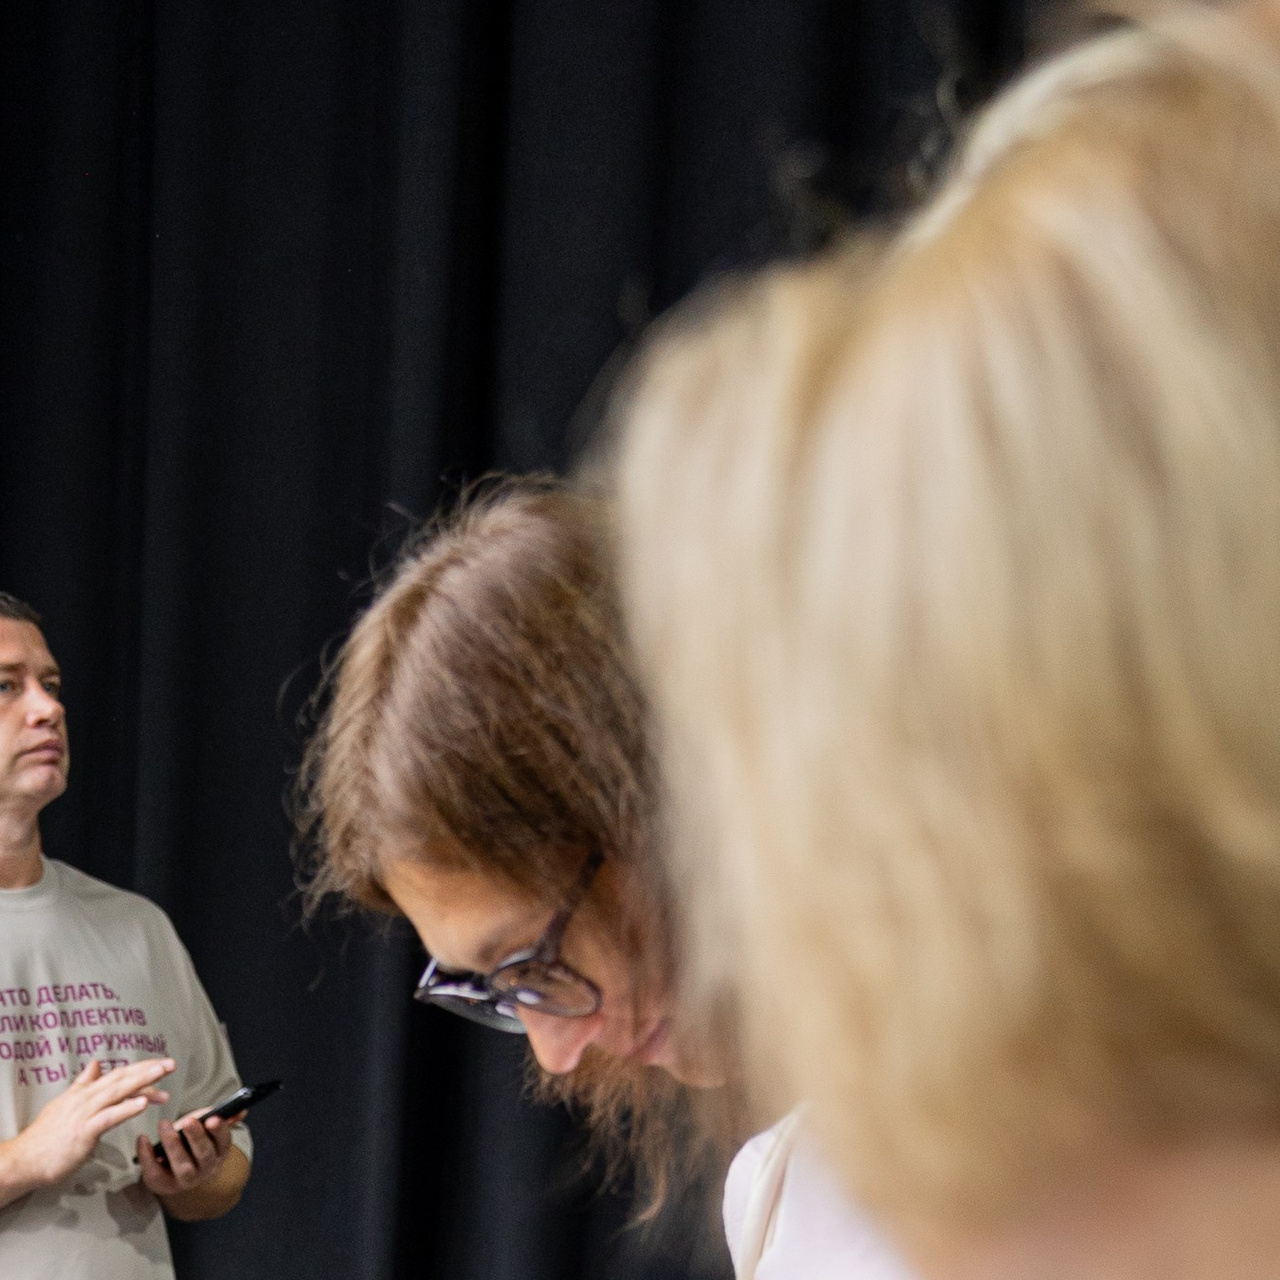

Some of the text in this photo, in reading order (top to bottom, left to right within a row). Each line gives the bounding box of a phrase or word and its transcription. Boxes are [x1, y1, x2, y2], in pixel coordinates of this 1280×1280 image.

[28, 1006, 148, 1033] КОЛЛЕКТИВ
[57, 1036, 72, 1054] И
[30, 1062, 68, 1086] ТЫ
